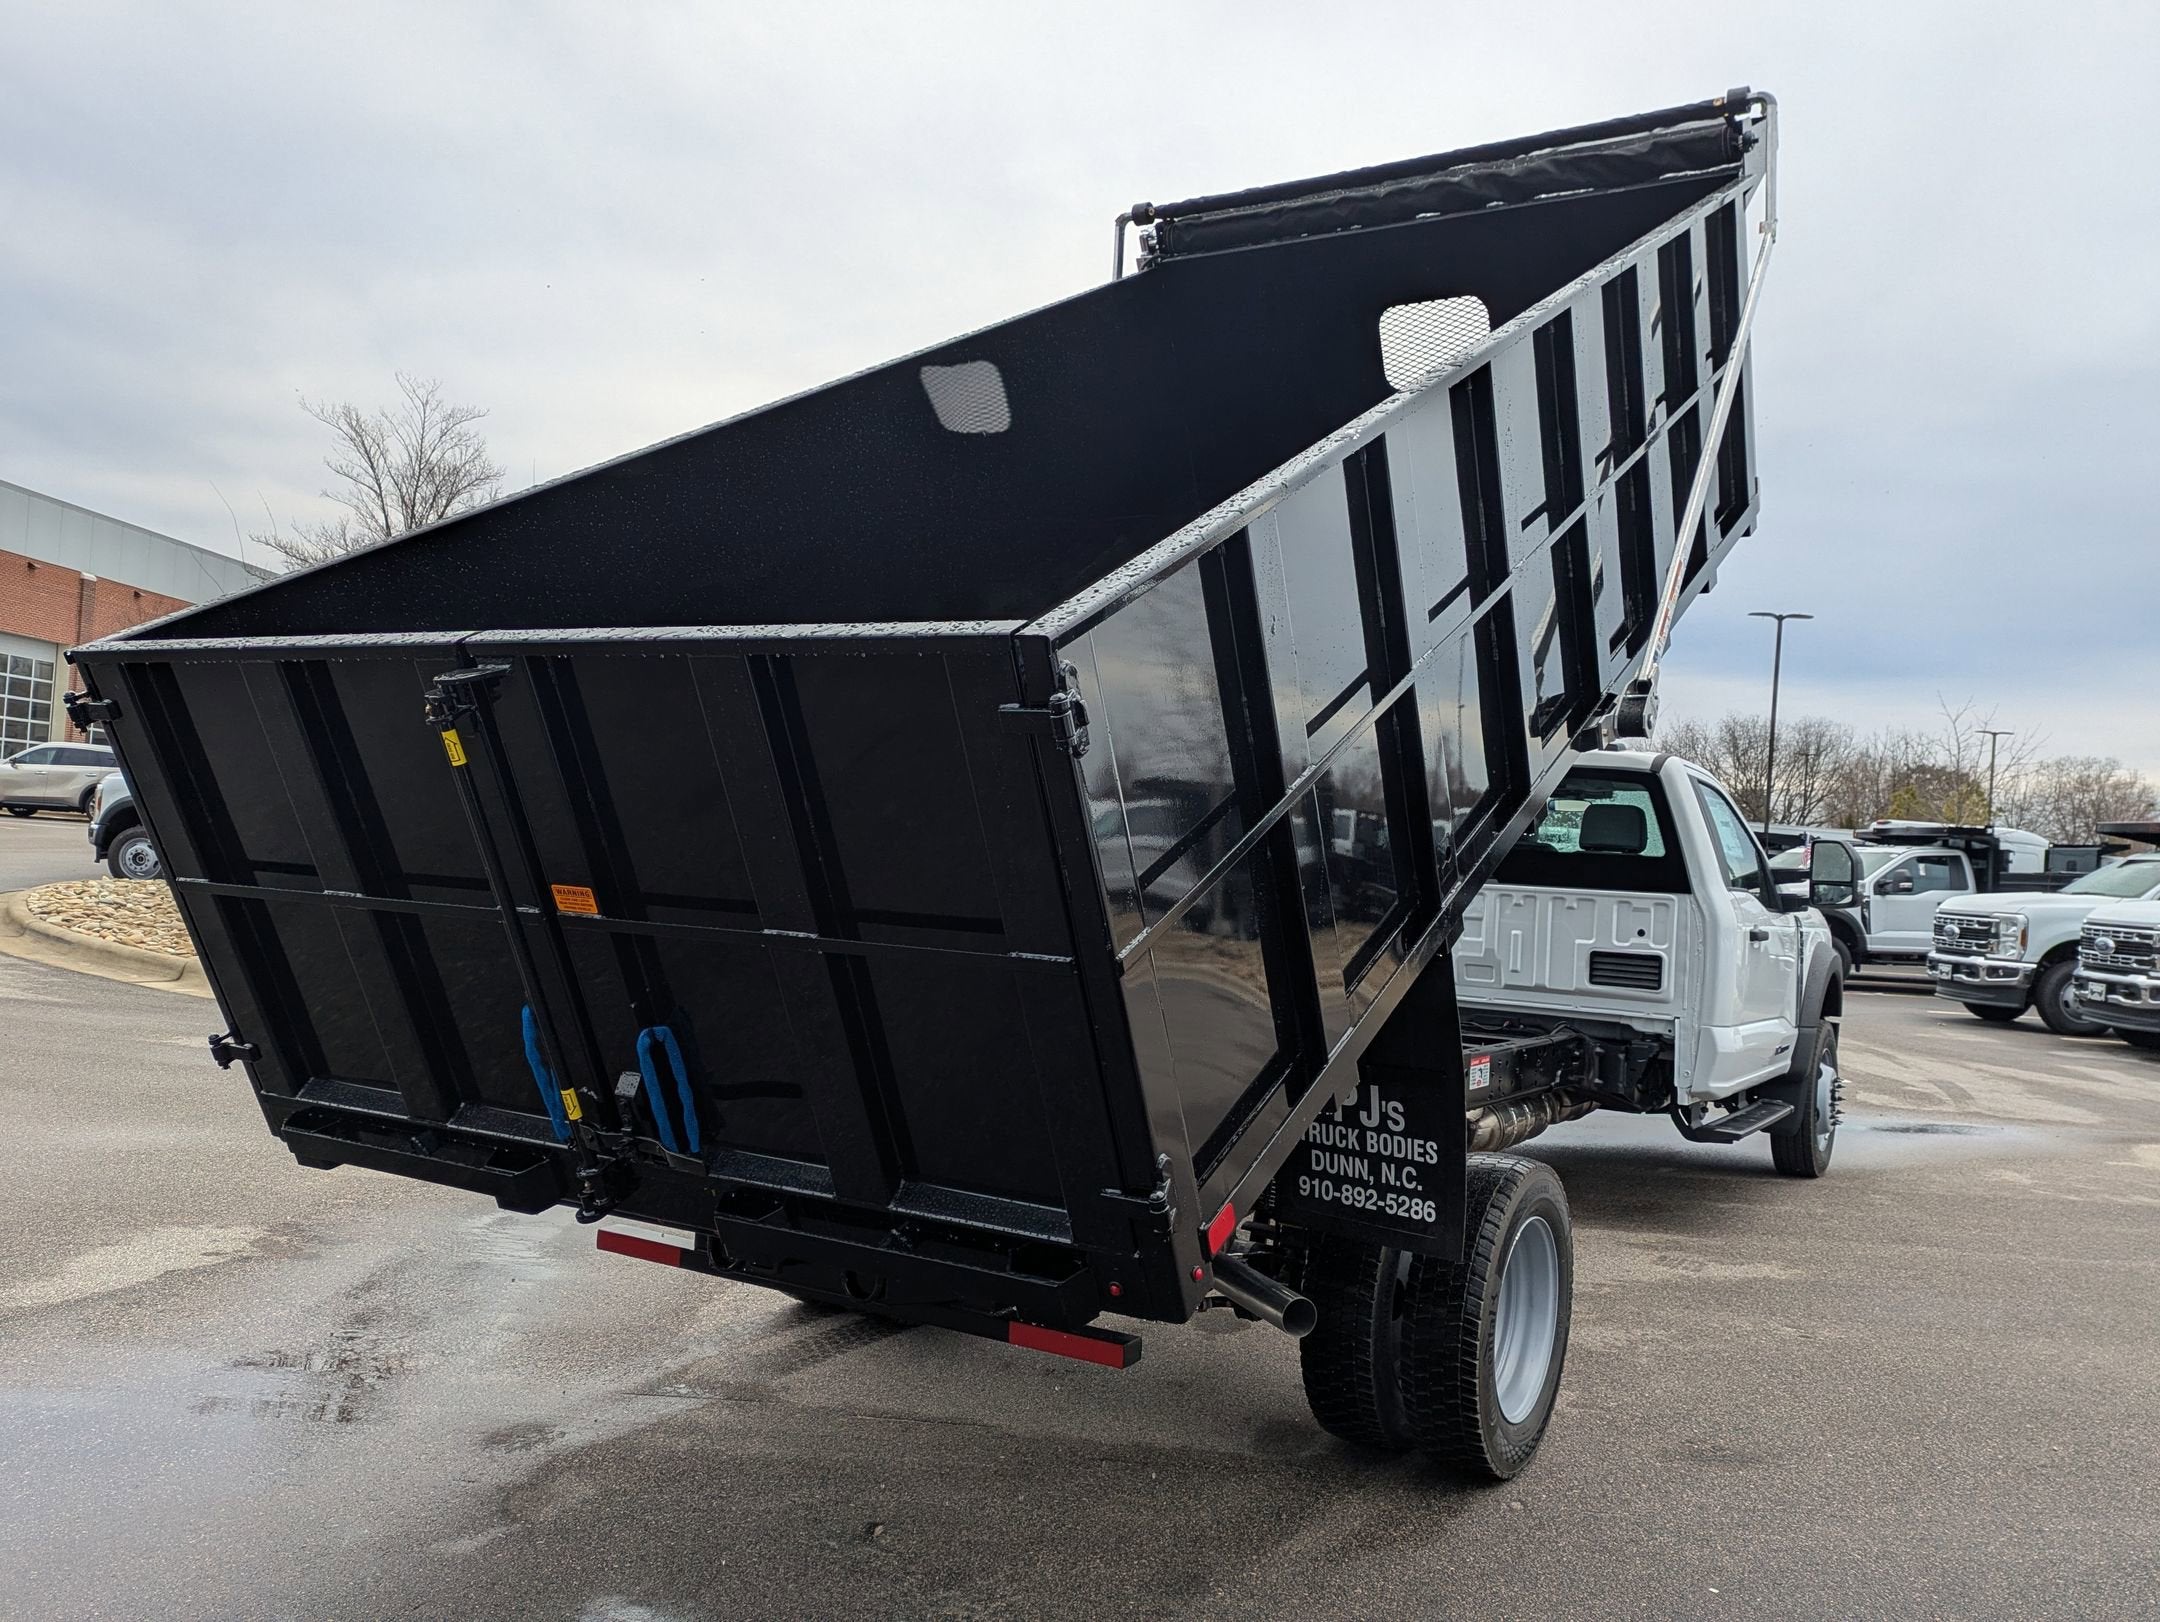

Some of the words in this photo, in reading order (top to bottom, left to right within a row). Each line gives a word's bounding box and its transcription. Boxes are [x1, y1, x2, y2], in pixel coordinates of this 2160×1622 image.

[555, 888, 591, 898] WARNING
[1301, 1122, 1360, 1151] RUCK
[1366, 1131, 1438, 1164] BODIES
[1311, 1149, 1374, 1186] DUNN,
[1381, 1162, 1423, 1191] N.C.
[1299, 1175, 1437, 1223] 910-892-5286
